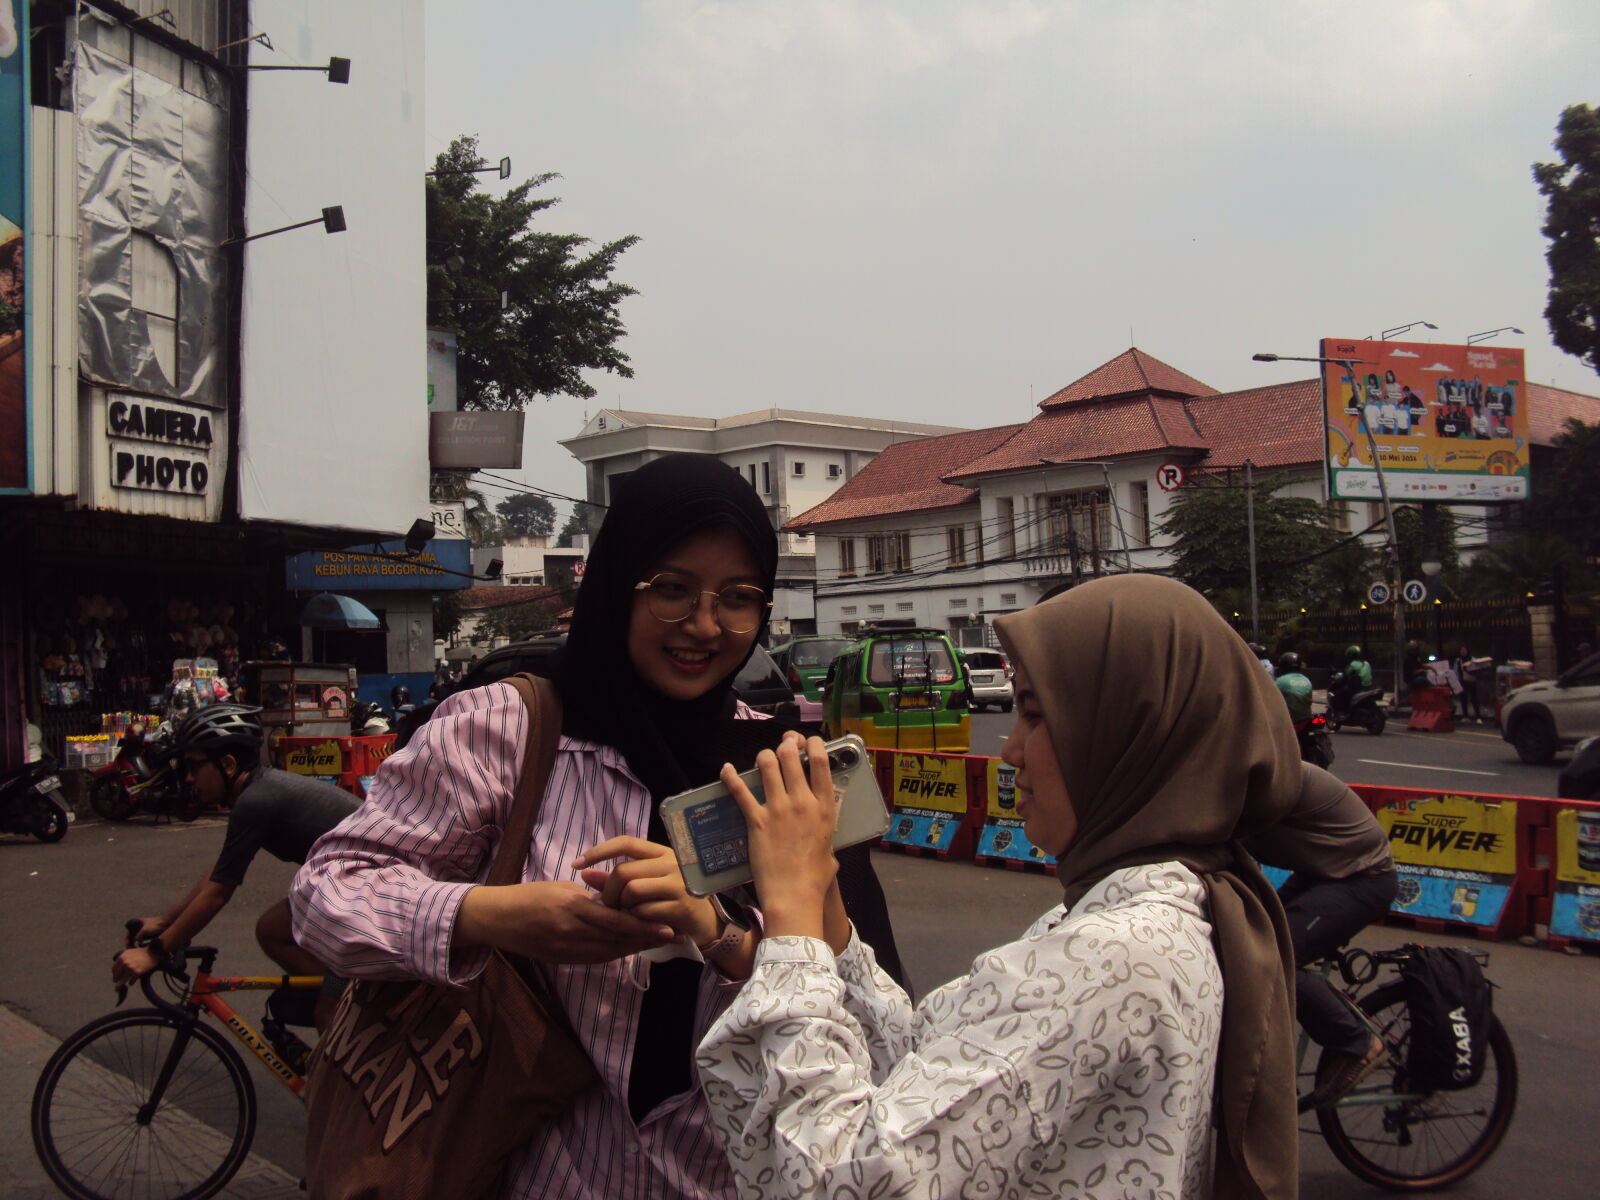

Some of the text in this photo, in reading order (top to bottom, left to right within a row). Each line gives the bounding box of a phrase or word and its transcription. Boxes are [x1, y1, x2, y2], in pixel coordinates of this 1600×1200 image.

[109, 401, 213, 445] CAMERA
[448, 417, 477, 431] J&T
[116, 452, 208, 491] PHOTO
[323, 552, 345, 563] POS
[314, 564, 351, 576] KEBUN
[353, 564, 378, 576] RAYA
[381, 564, 417, 576] BOGOR
[290, 755, 335, 769] POWER
[899, 760, 915, 768] ABC
[918, 770, 941, 782] Super
[999, 775, 1014, 784] ABC
[899, 779, 959, 799] POWER
[1387, 800, 1417, 811] ABC
[1422, 813, 1467, 828] Super
[1389, 823, 1500, 853] POWER
[228, 1017, 293, 1081] POLYGON
